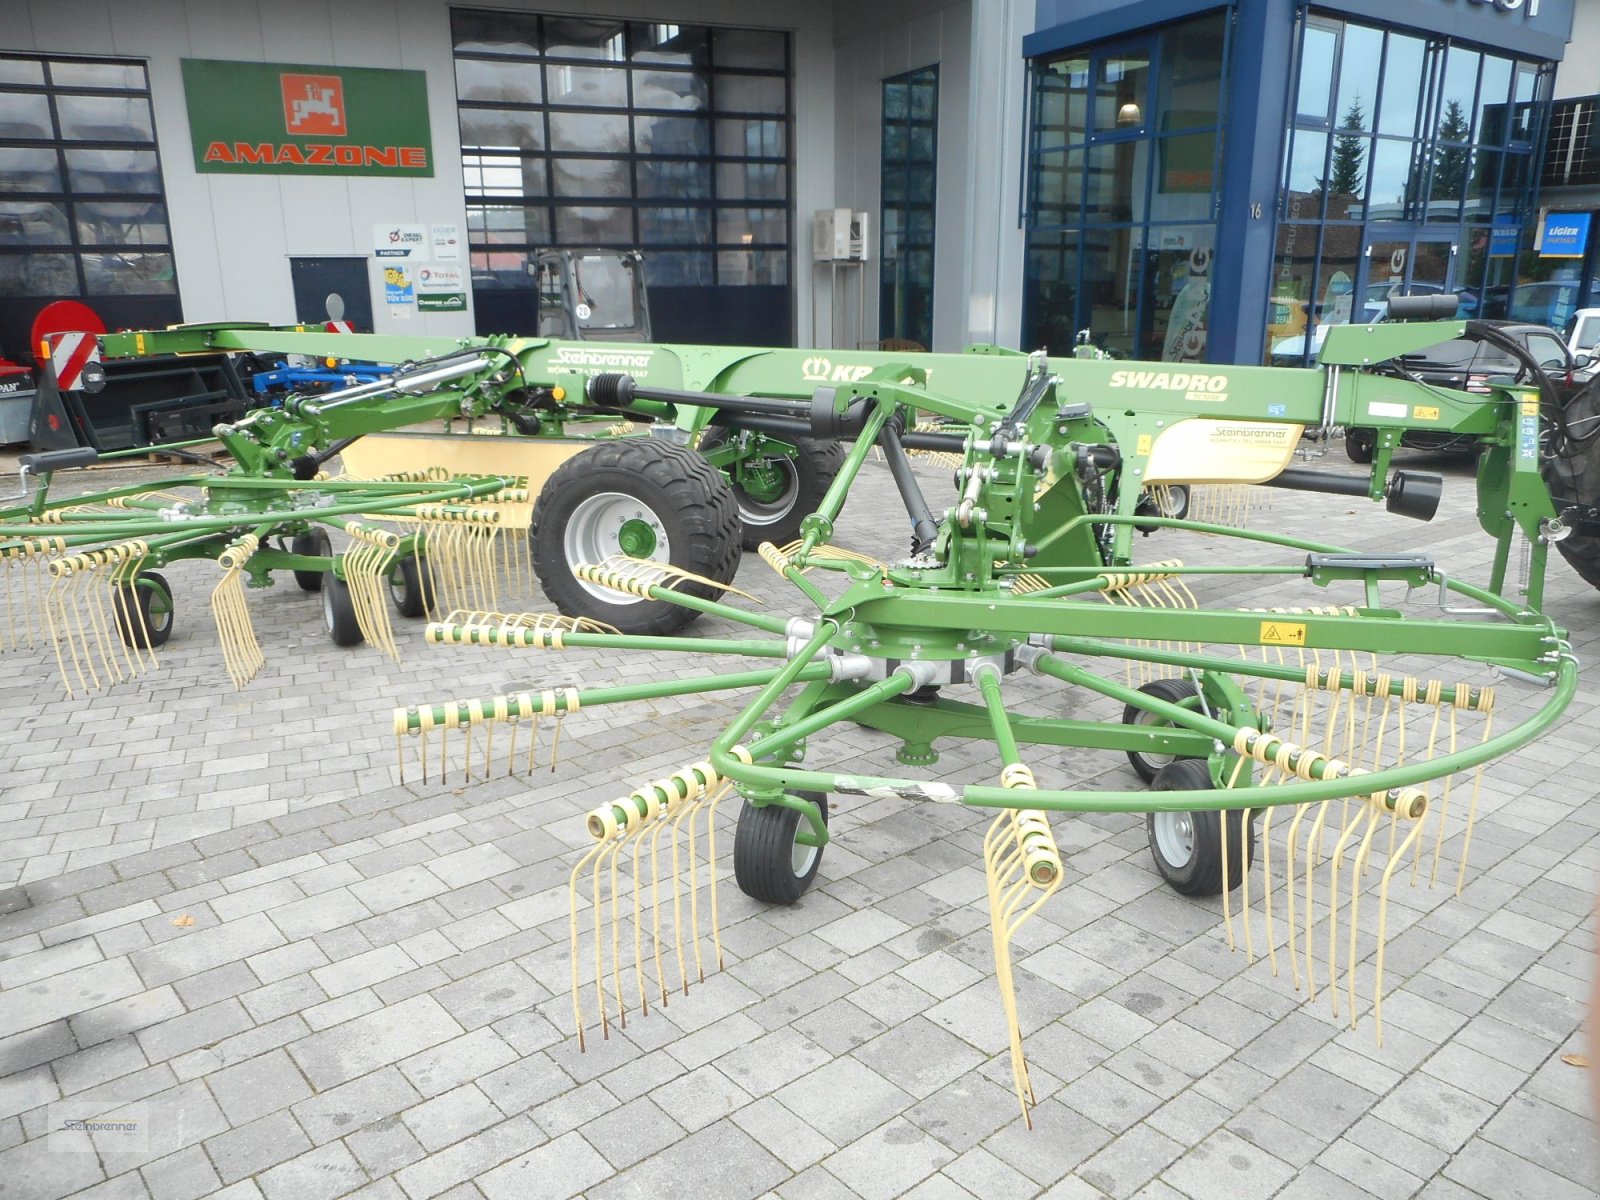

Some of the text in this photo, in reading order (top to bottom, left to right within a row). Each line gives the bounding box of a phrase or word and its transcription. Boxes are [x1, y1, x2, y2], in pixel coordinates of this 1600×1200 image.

[203, 142, 427, 167] AMAZONE
[1250, 203, 1261, 219] 16
[578, 306, 589, 317] 20
[548, 348, 654, 367] Steinbrenner
[547, 366, 583, 374] WÖRNTZ
[1109, 371, 1228, 392] SWADRO
[1210, 427, 1288, 438] Steinbrenner
